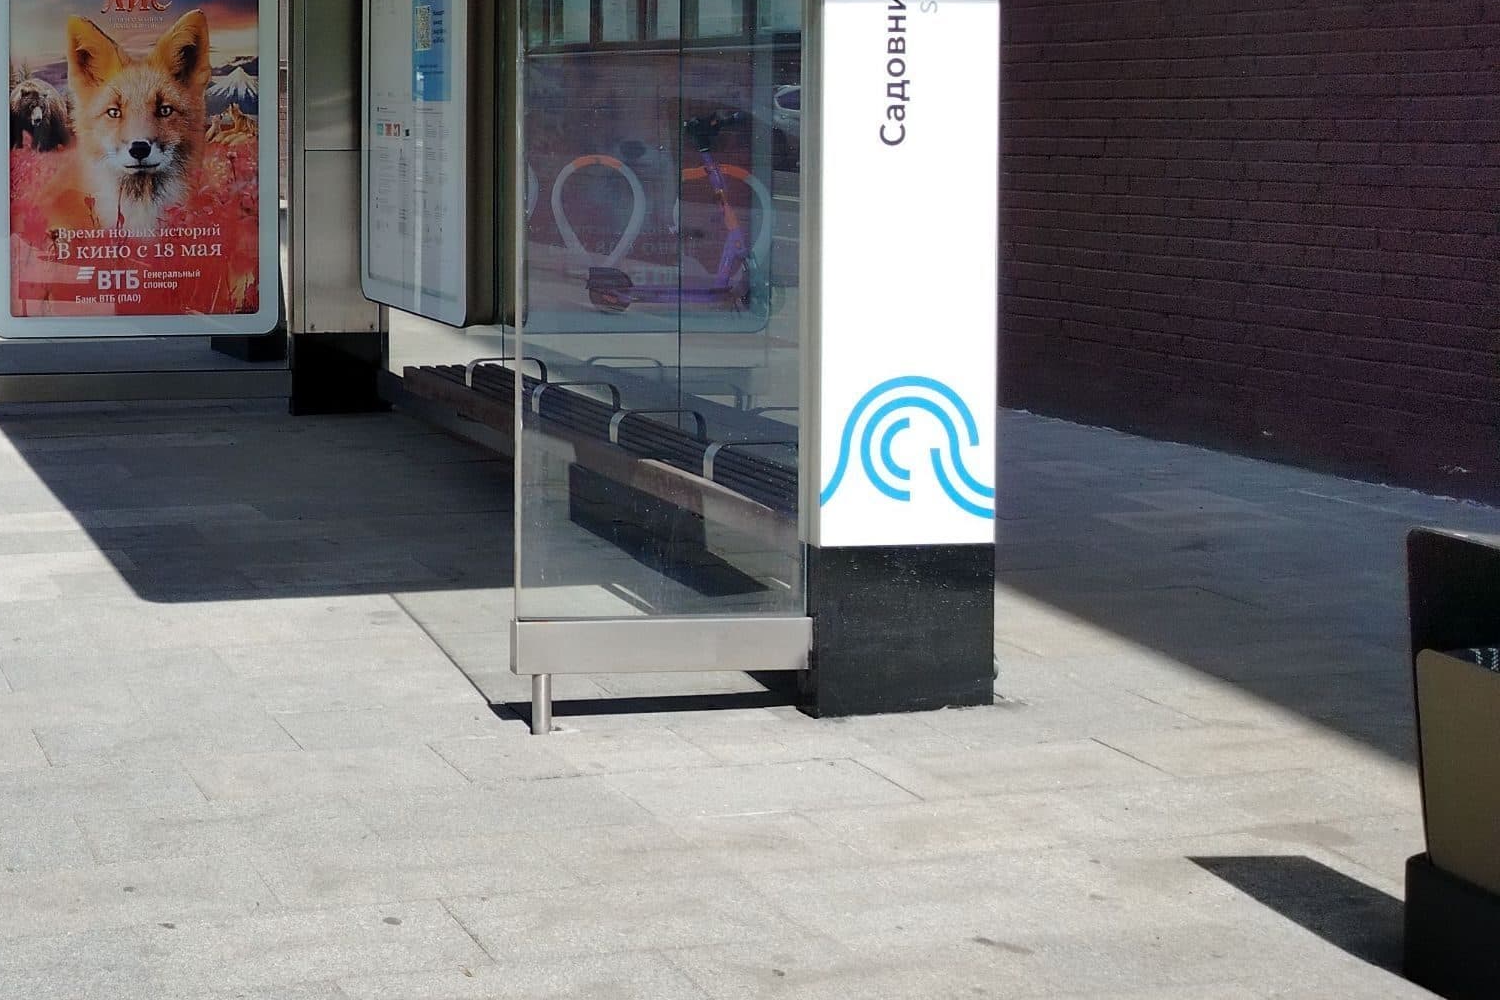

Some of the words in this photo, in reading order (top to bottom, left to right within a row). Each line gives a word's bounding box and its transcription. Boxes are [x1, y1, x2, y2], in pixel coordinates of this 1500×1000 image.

[58, 226, 105, 242] Время
[109, 227, 156, 239] новых
[159, 224, 221, 240] историй
[56, 242, 71, 260] В
[76, 244, 132, 259] кино
[136, 245, 148, 258] с
[153, 243, 175, 258] 18
[181, 242, 223, 258] мая
[97, 269, 140, 290] ВТБ
[143, 268, 202, 280] Генеральный
[143, 280, 179, 291] спонсор
[75, 295, 98, 304] Банк
[100, 294, 116, 303] ВТБ
[117, 293, 142, 304] (ПАО)
